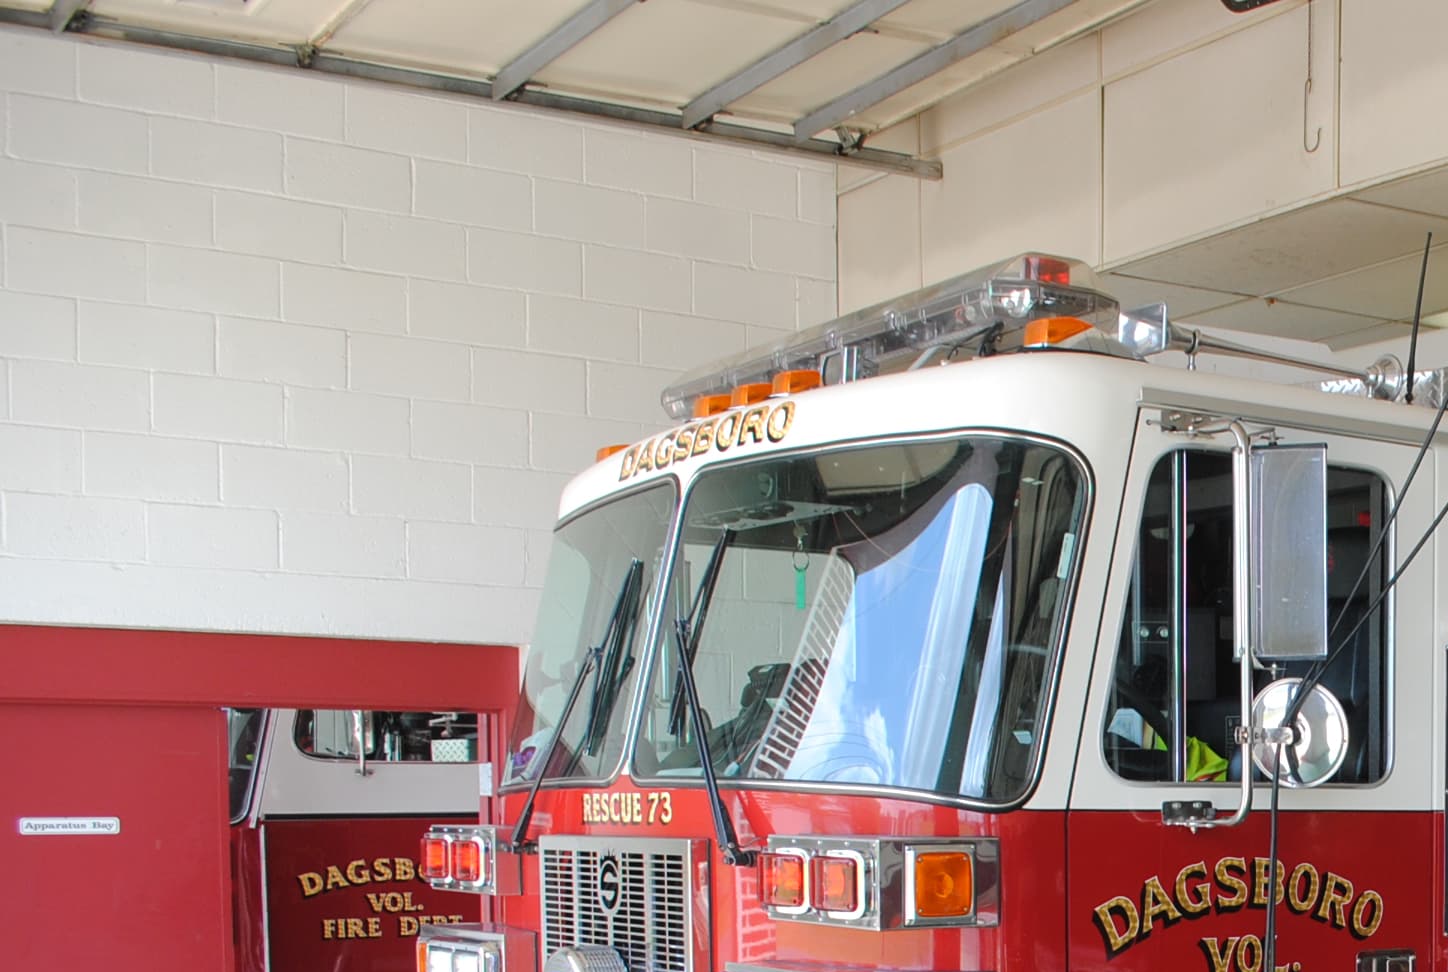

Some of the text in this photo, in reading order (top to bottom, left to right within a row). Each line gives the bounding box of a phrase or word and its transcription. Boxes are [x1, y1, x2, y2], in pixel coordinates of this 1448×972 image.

[619, 401, 796, 482] DAGSBORO
[582, 791, 672, 824] RESCUE 73
[25, 822, 114, 831] Apparatus Bay
[297, 856, 426, 898] DAGSB
[367, 891, 424, 913] VOL.
[1092, 855, 1384, 957] DAGSBORO
[323, 916, 382, 939] FIRE
